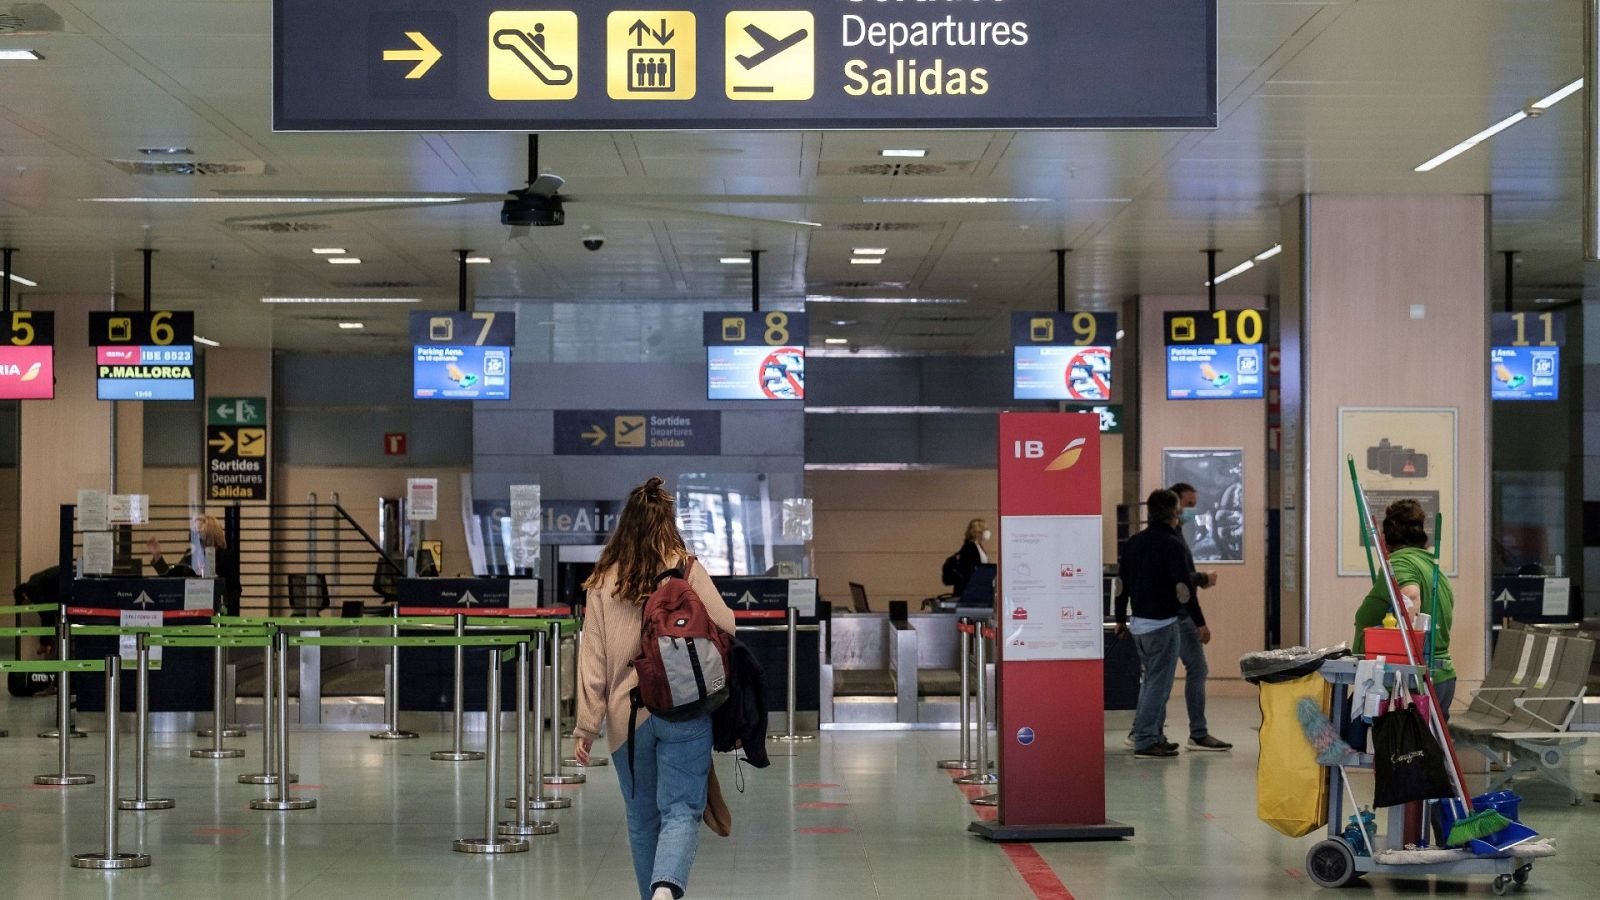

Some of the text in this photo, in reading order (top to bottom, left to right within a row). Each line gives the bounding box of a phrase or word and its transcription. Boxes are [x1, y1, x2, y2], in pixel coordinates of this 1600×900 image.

[842, 14, 1029, 54] Departures
[843, 59, 989, 96] Salidas
[11, 311, 35, 346] 5
[150, 310, 174, 346] 6
[472, 312, 496, 346] 7
[764, 310, 789, 346] 8
[1072, 311, 1097, 346] 9
[1212, 308, 1263, 345] 10
[1511, 311, 1557, 346] 11
[100, 366, 192, 378] P.MALLORCA
[650, 416, 691, 426] Sortides
[650, 427, 693, 438] Departures
[650, 438, 685, 448] Salidas
[1014, 440, 1045, 459] IB
[211, 458, 260, 471] Sortides
[211, 472, 263, 485] Departures
[211, 485, 253, 498] Salidas
